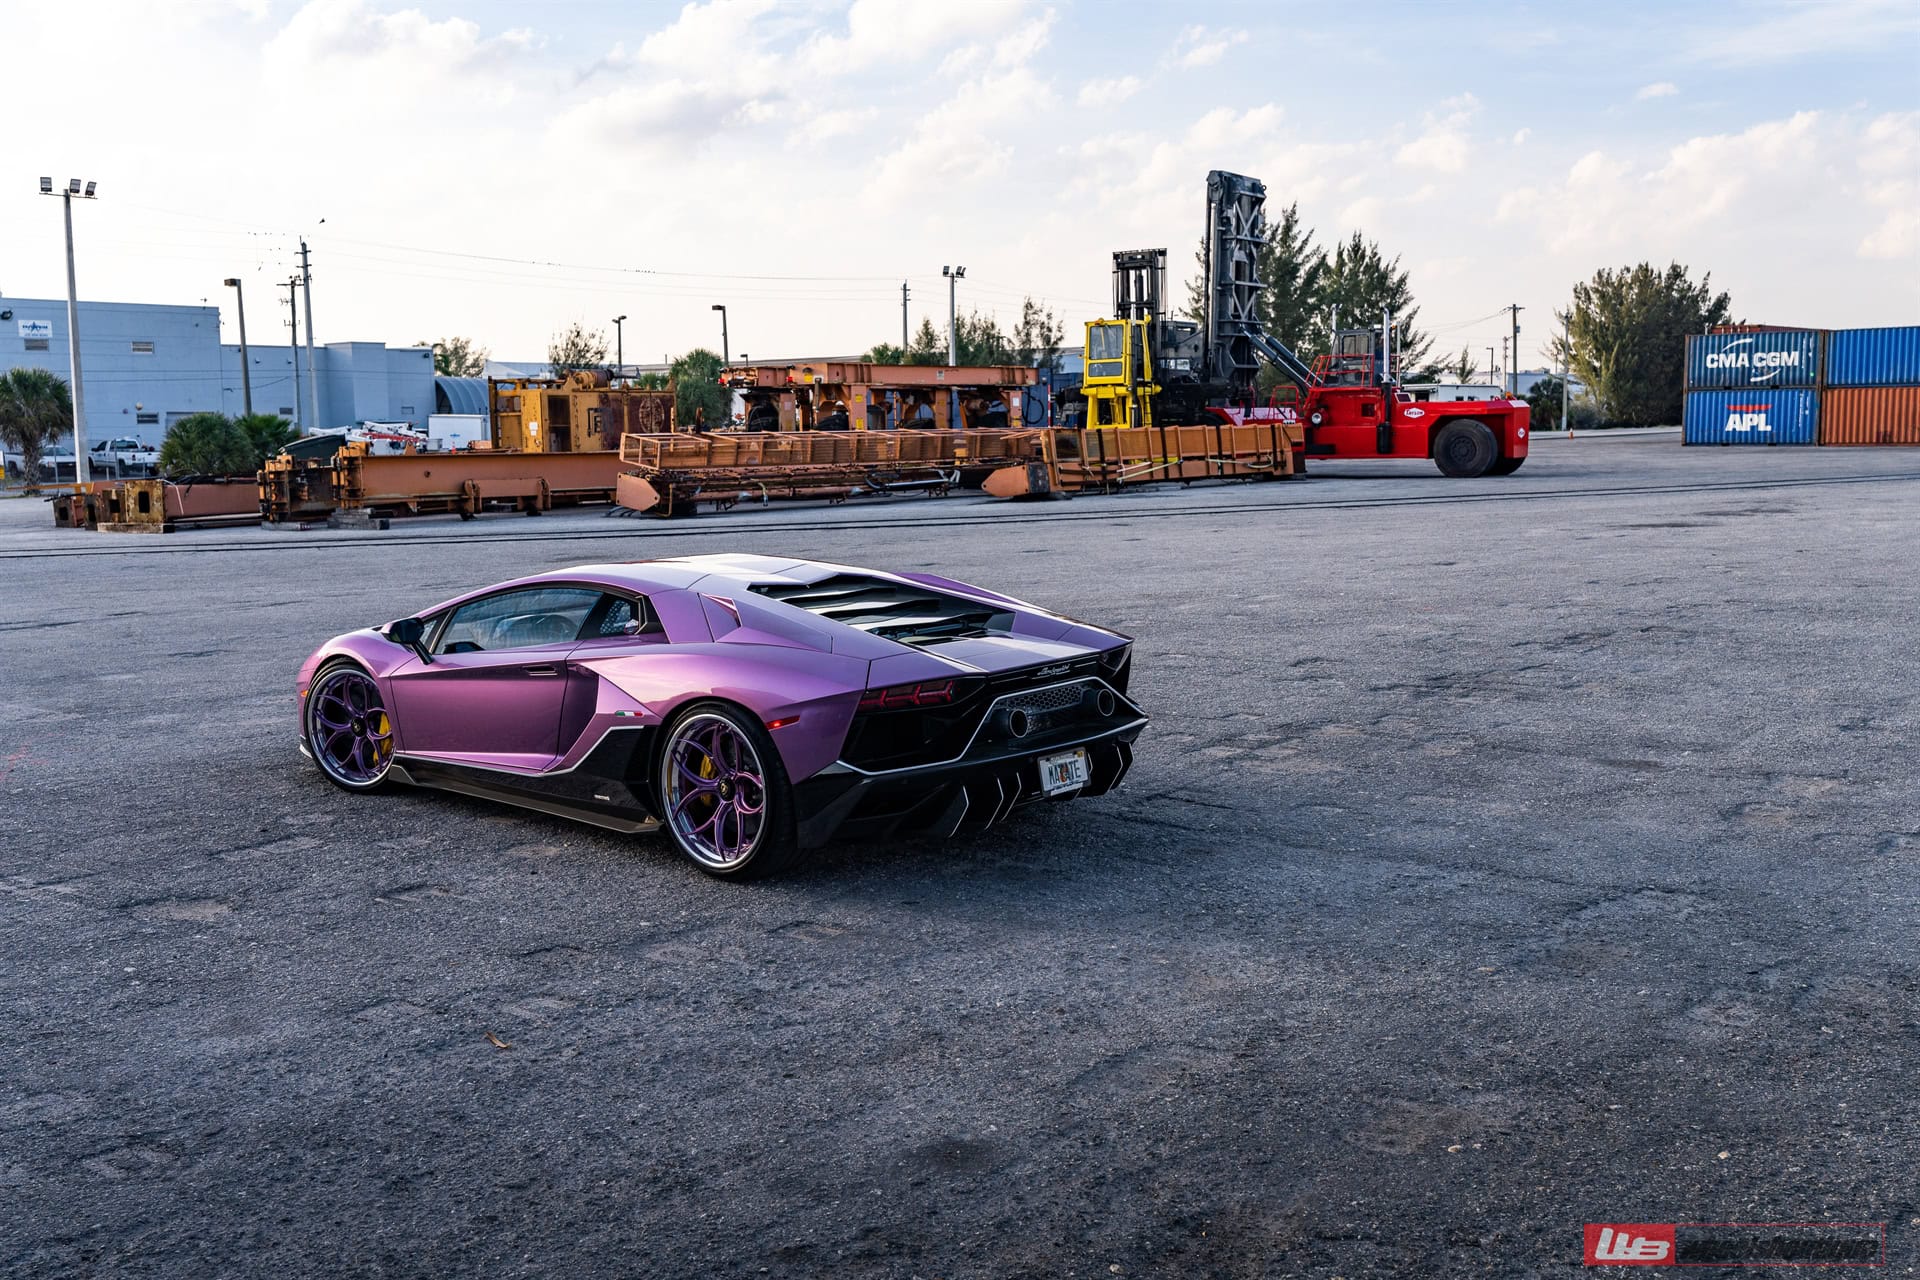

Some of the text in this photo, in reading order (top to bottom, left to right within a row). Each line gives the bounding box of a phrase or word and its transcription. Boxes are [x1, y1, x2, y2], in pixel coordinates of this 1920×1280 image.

[1706, 353, 1749, 368] CMA
[1753, 351, 1799, 367] CGM
[1725, 413, 1772, 431] APL
